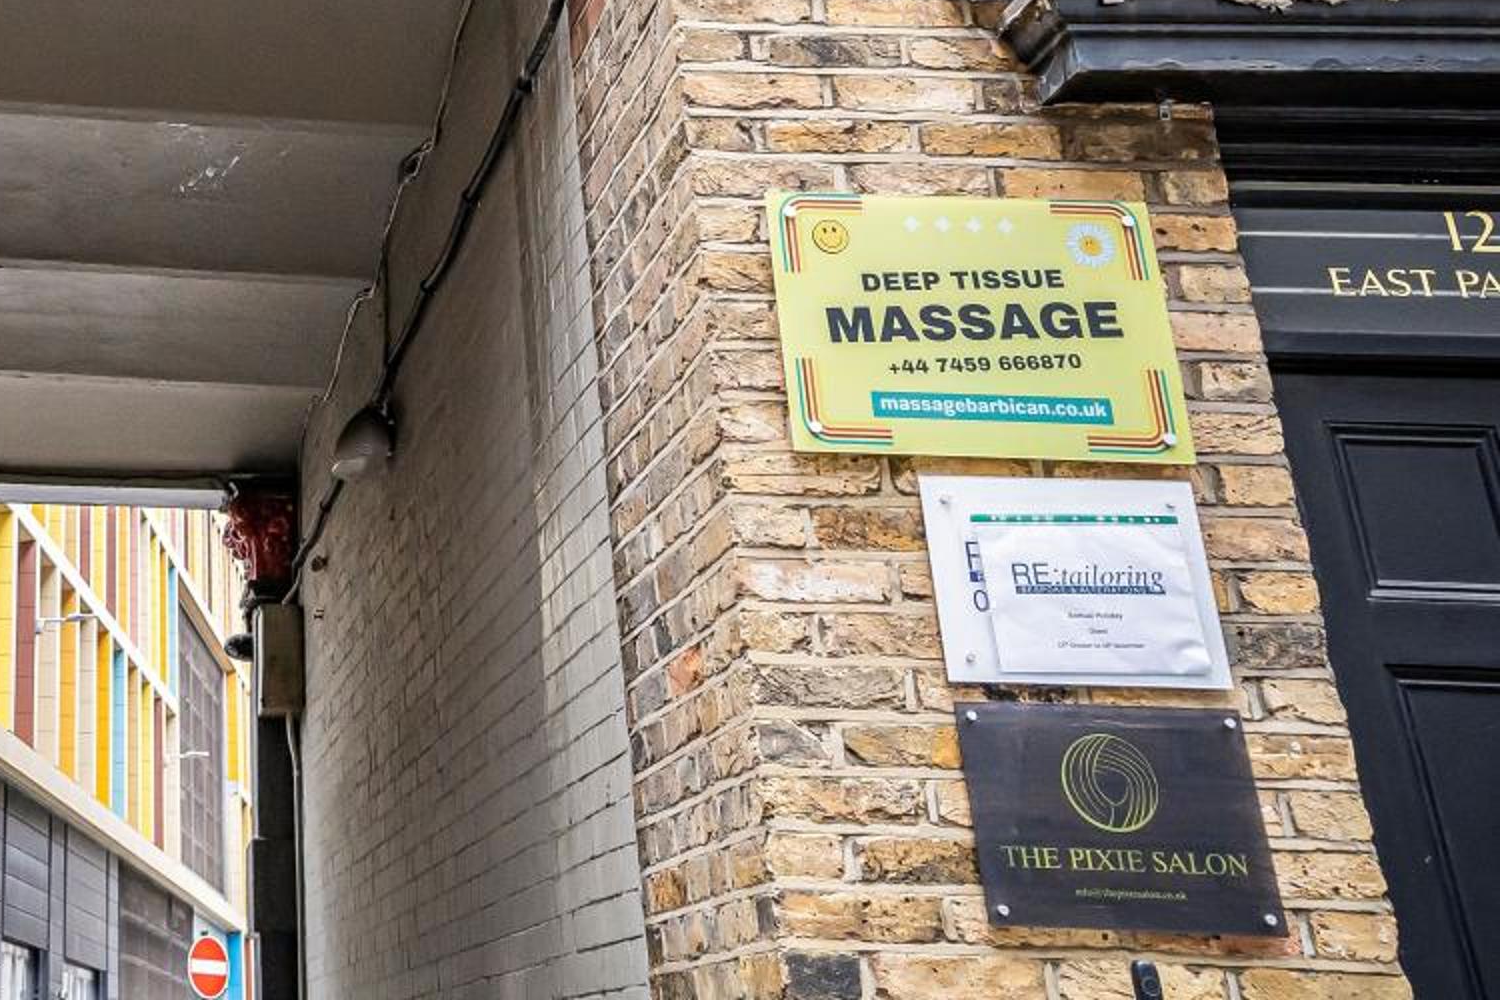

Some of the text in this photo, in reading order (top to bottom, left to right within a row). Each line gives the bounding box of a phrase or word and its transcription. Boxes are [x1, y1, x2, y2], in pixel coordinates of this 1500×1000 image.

[1443, 211, 1500, 253] 12
[861, 269, 1064, 292] DEEP TISSUE
[1327, 267, 1436, 297] EAST
[826, 301, 1125, 344] MASSAGE
[889, 353, 1082, 376] +44 7459 666870
[879, 396, 1107, 419] massagebarbican.co.uk
[1011, 563, 1165, 592] RE:tailoring
[1000, 846, 1250, 876] THE PIXIE SALON
